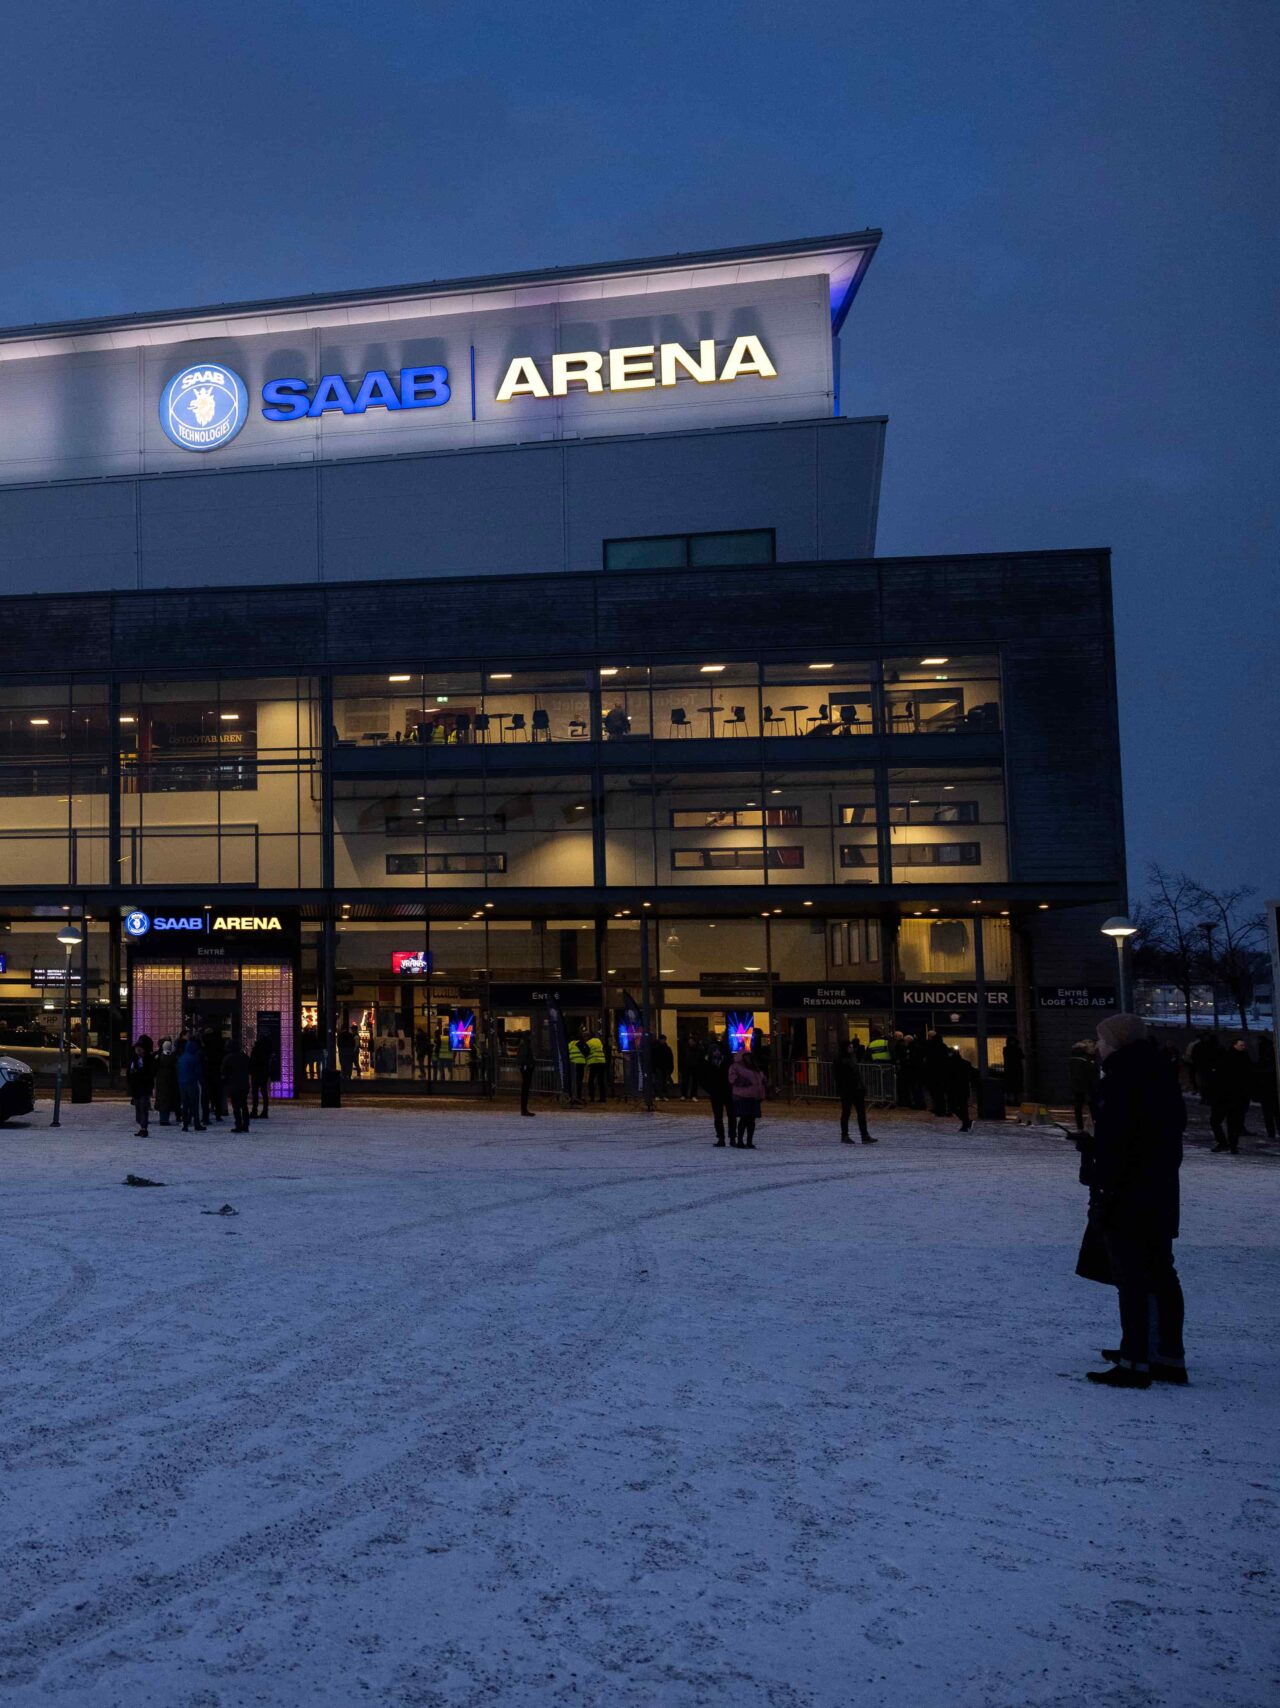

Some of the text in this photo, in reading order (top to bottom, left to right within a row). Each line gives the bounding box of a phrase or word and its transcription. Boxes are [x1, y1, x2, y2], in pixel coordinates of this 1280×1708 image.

[181, 371, 225, 390] SAAB
[261, 334, 778, 421] SAAB ARENA
[178, 419, 231, 443] TECHNOLOGIES
[153, 917, 283, 930] SAAB ARENA
